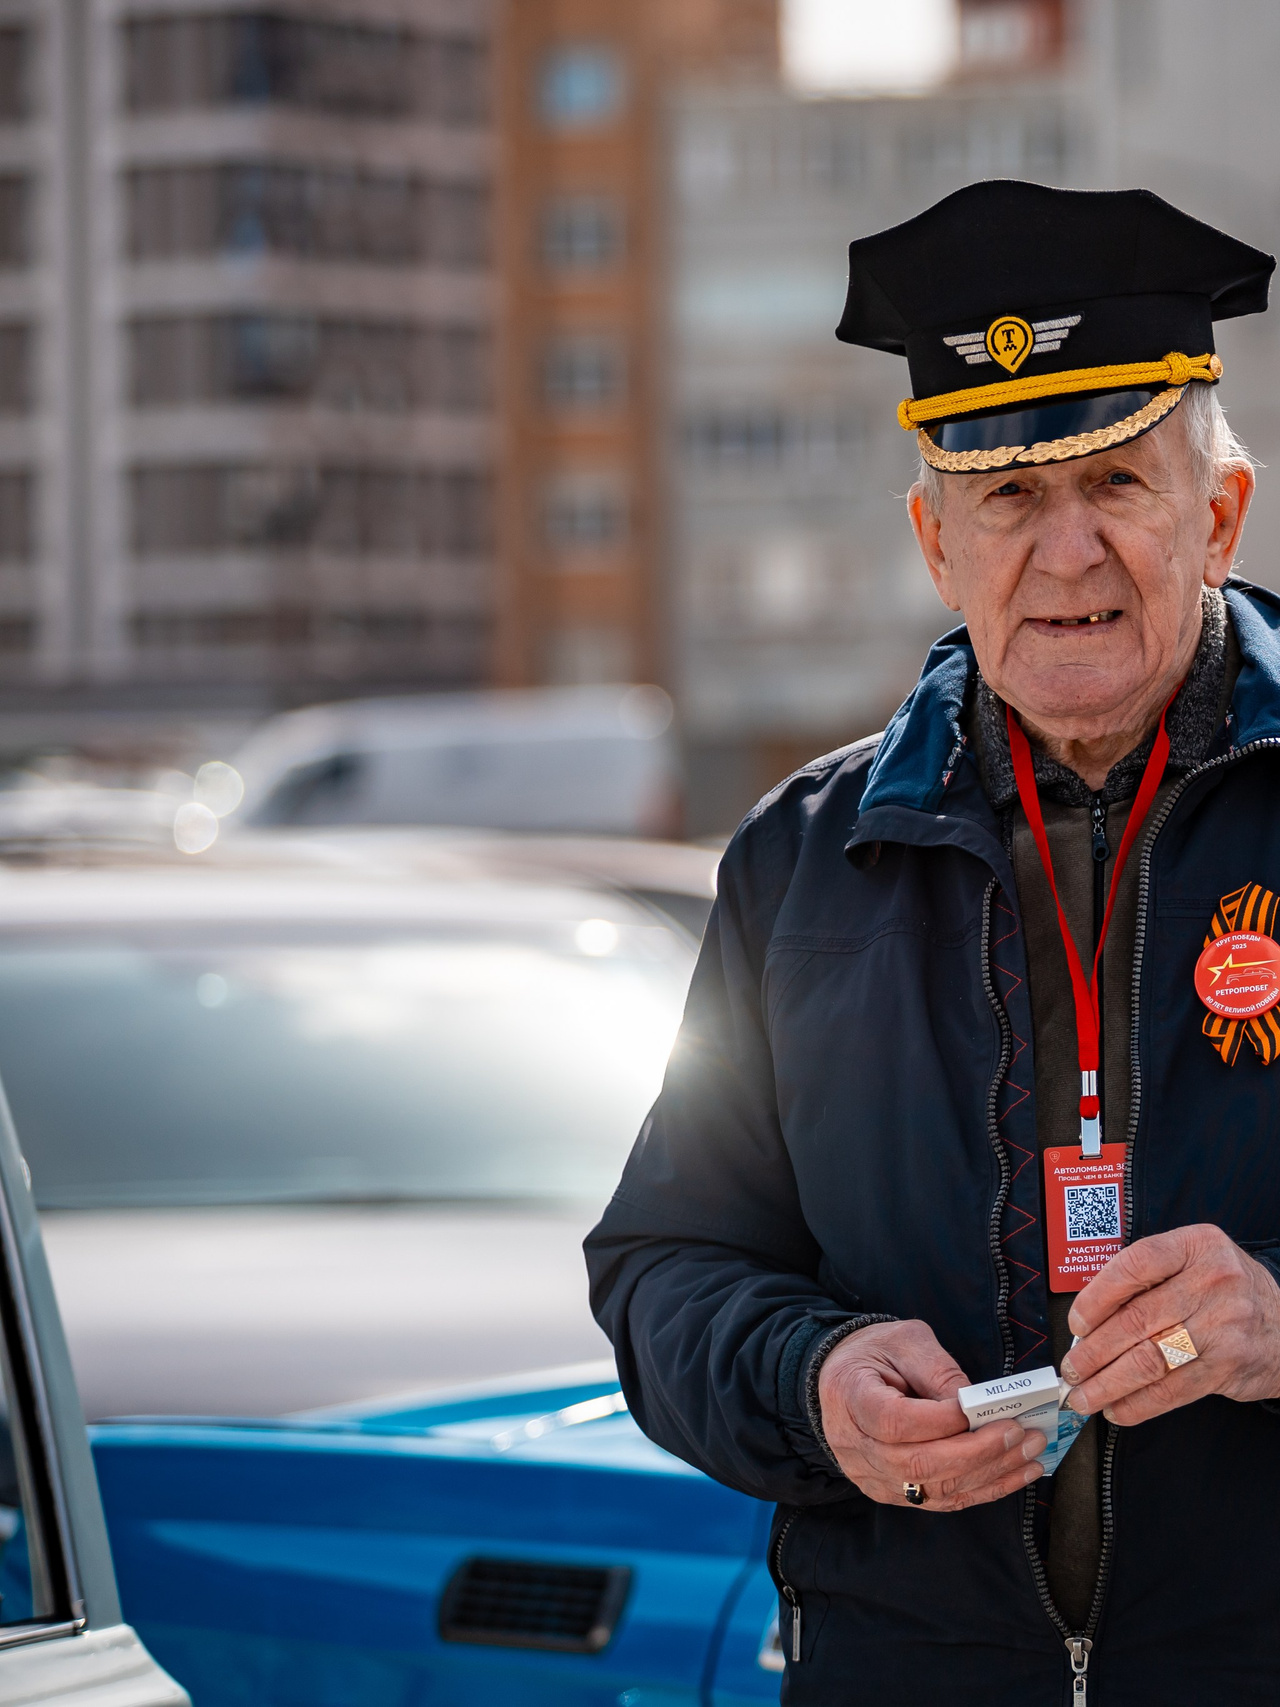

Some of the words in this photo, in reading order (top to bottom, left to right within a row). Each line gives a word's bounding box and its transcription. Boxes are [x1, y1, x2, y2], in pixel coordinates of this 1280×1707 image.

[1216, 937, 1231, 948] КРУГ
[1232, 934, 1261, 942] ПОБЕДЫ
[1215, 984, 1269, 997] РЕТРОПРОБЕГ
[1205, 995, 1214, 1004] 80
[1212, 1000, 1224, 1010] ЛЕТ
[1224, 1004, 1256, 1014] ВЕЛИКОЙ
[1256, 988, 1280, 1009] ПОБЕДЫ
[1067, 1244, 1122, 1255] УЧАСТВУЙТЕ
[1057, 1265, 1089, 1273] ТОННЫ
[985, 1378, 1032, 1397] MILANO
[976, 1402, 1022, 1418] MILANO
